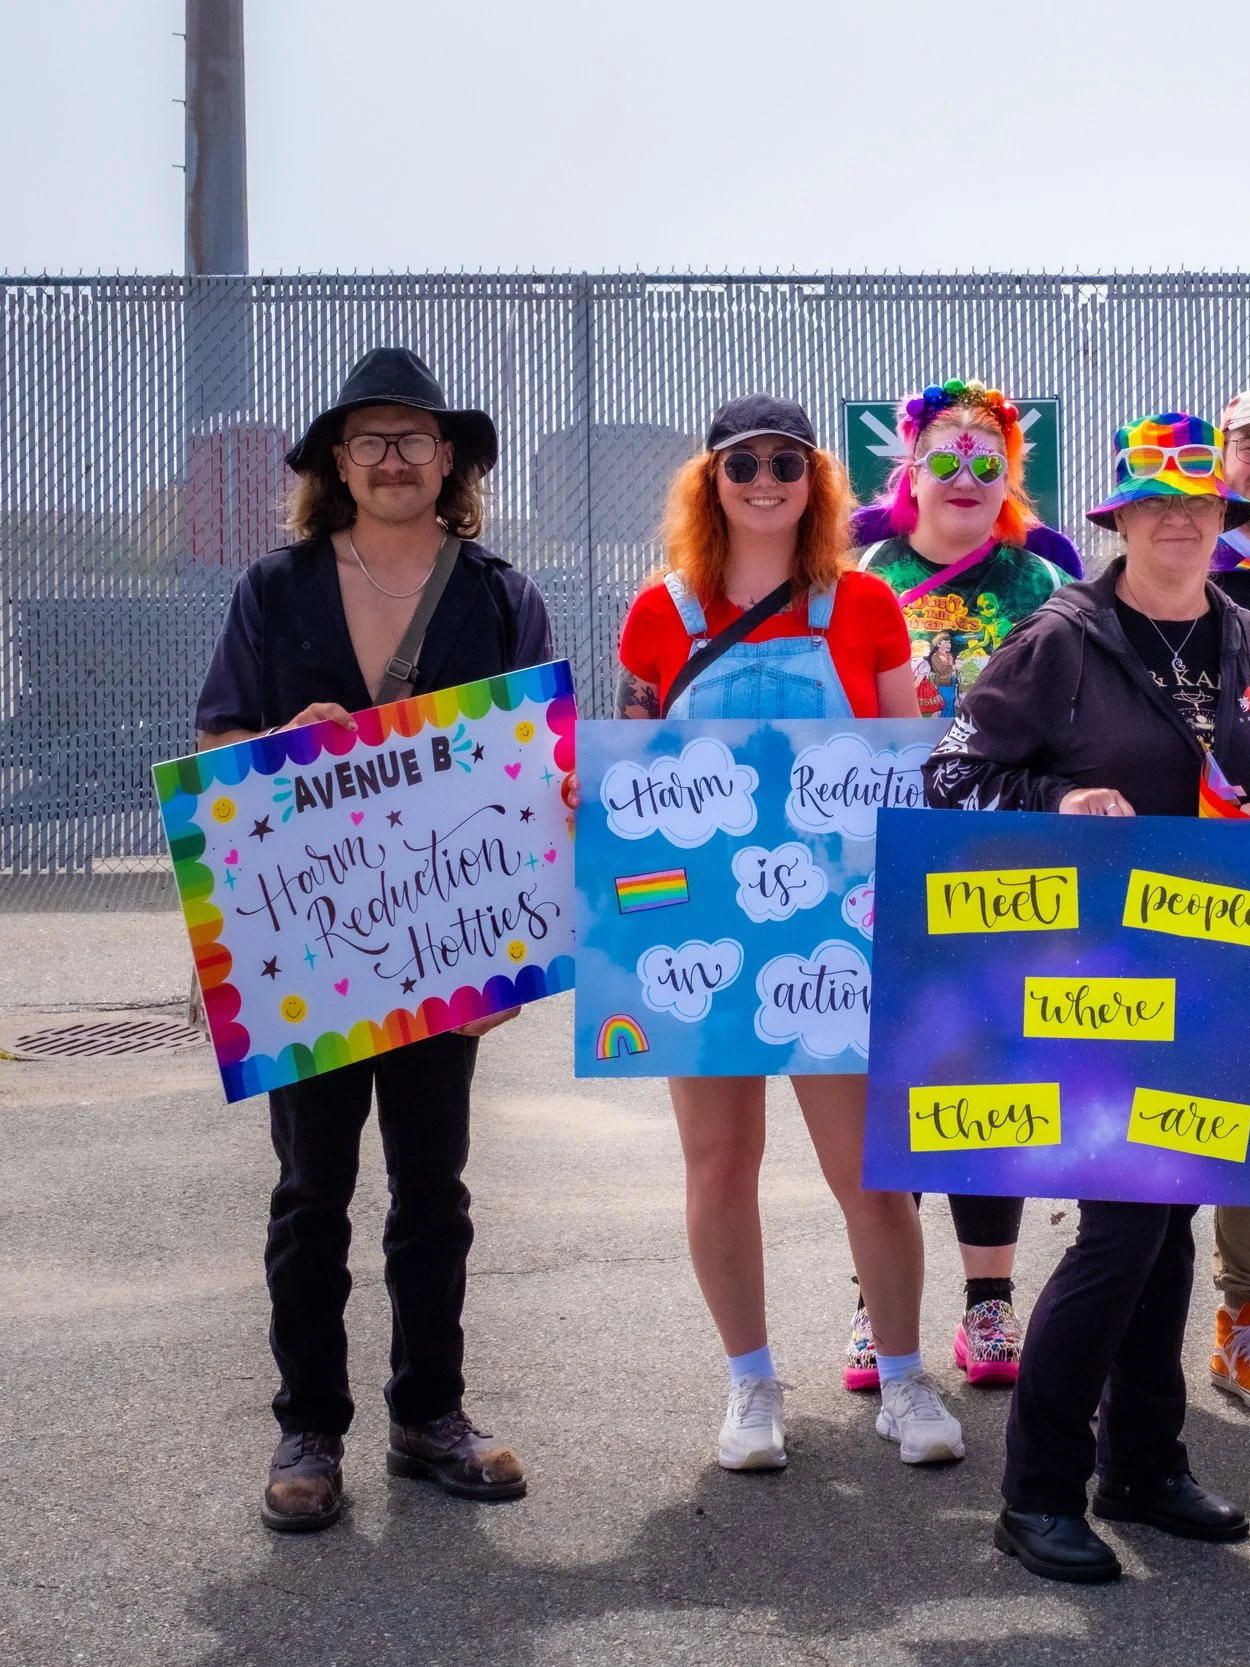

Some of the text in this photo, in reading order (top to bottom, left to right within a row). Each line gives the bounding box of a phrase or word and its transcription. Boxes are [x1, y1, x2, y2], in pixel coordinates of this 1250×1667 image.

[294, 735, 452, 814] AVENUE B
[609, 771, 734, 818] Harm
[235, 833, 386, 932] Harm
[307, 804, 521, 958] Reduction
[748, 857, 806, 906] is
[373, 882, 560, 979] Hotties
[658, 957, 722, 994] in
[1030, 985, 1165, 1030] where
[915, 1097, 1240, 1144] they are
